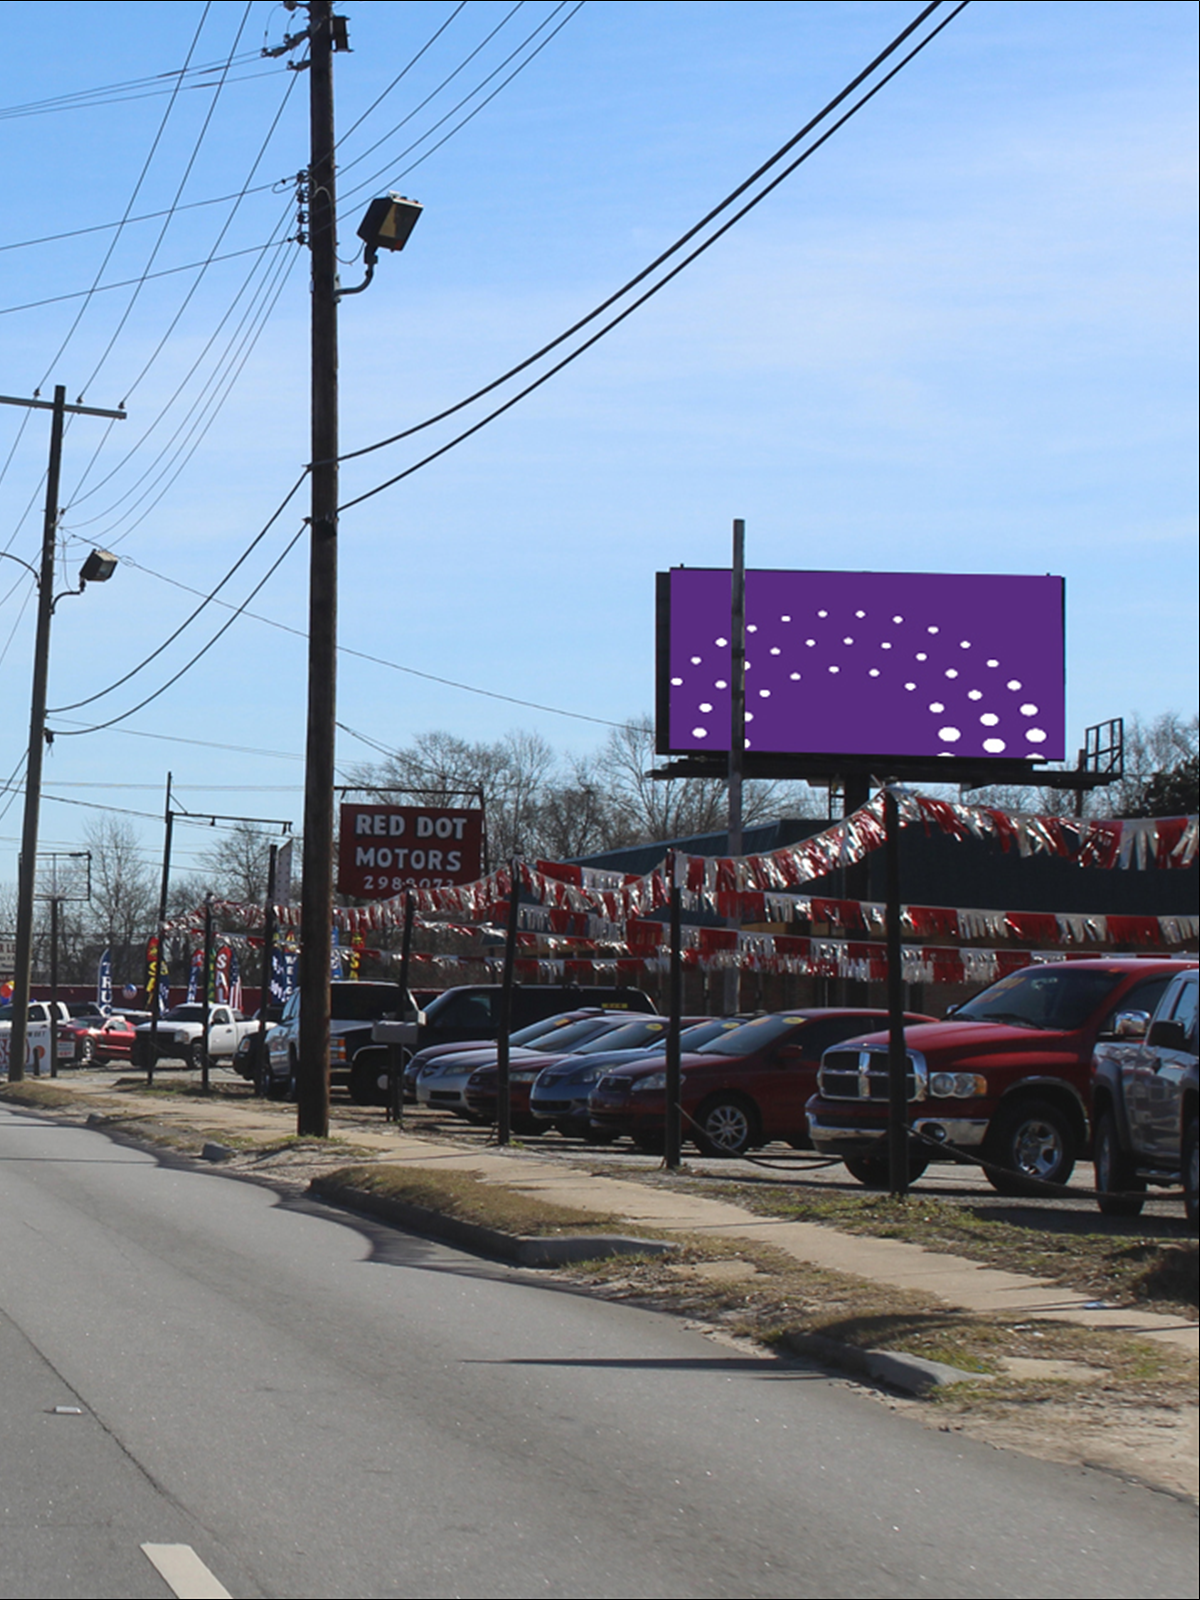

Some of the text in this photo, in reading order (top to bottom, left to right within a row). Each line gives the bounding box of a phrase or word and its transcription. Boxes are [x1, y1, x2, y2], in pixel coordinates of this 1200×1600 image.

[355, 813, 468, 840] RED DOT
[355, 846, 462, 872] MOTORS
